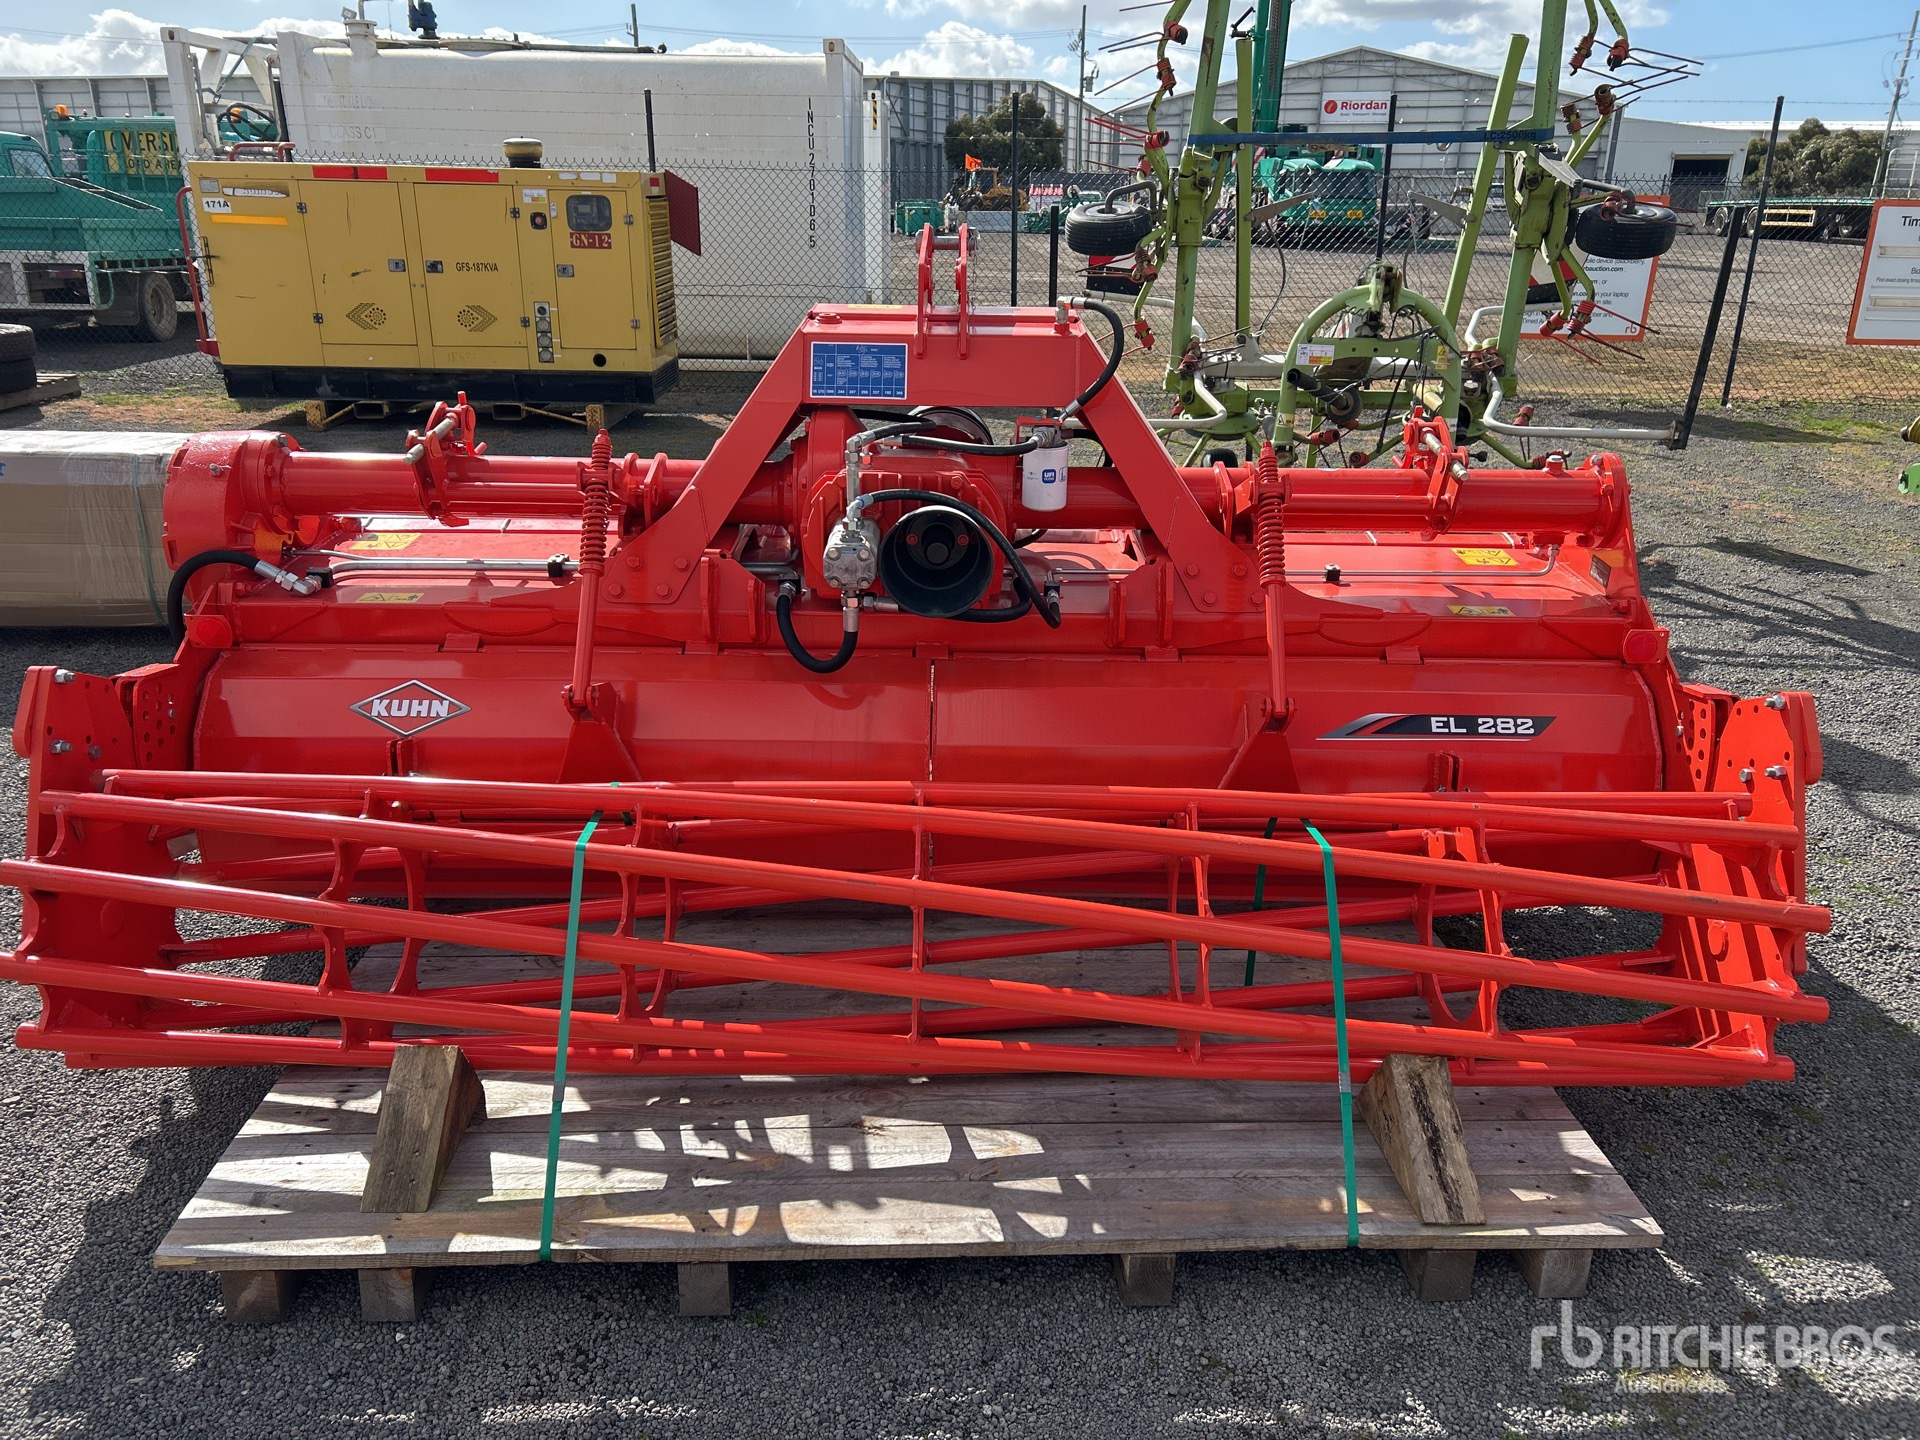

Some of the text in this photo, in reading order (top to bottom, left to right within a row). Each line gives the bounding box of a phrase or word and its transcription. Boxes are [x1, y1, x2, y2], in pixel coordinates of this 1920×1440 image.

[1340, 100, 1388, 111] Riordan
[204, 200, 230, 208] 171A
[455, 261, 499, 272] GFS-187KVA
[1612, 291, 1630, 299] laptop
[371, 699, 450, 718] KUHN
[1430, 717, 1535, 734] EL 282
